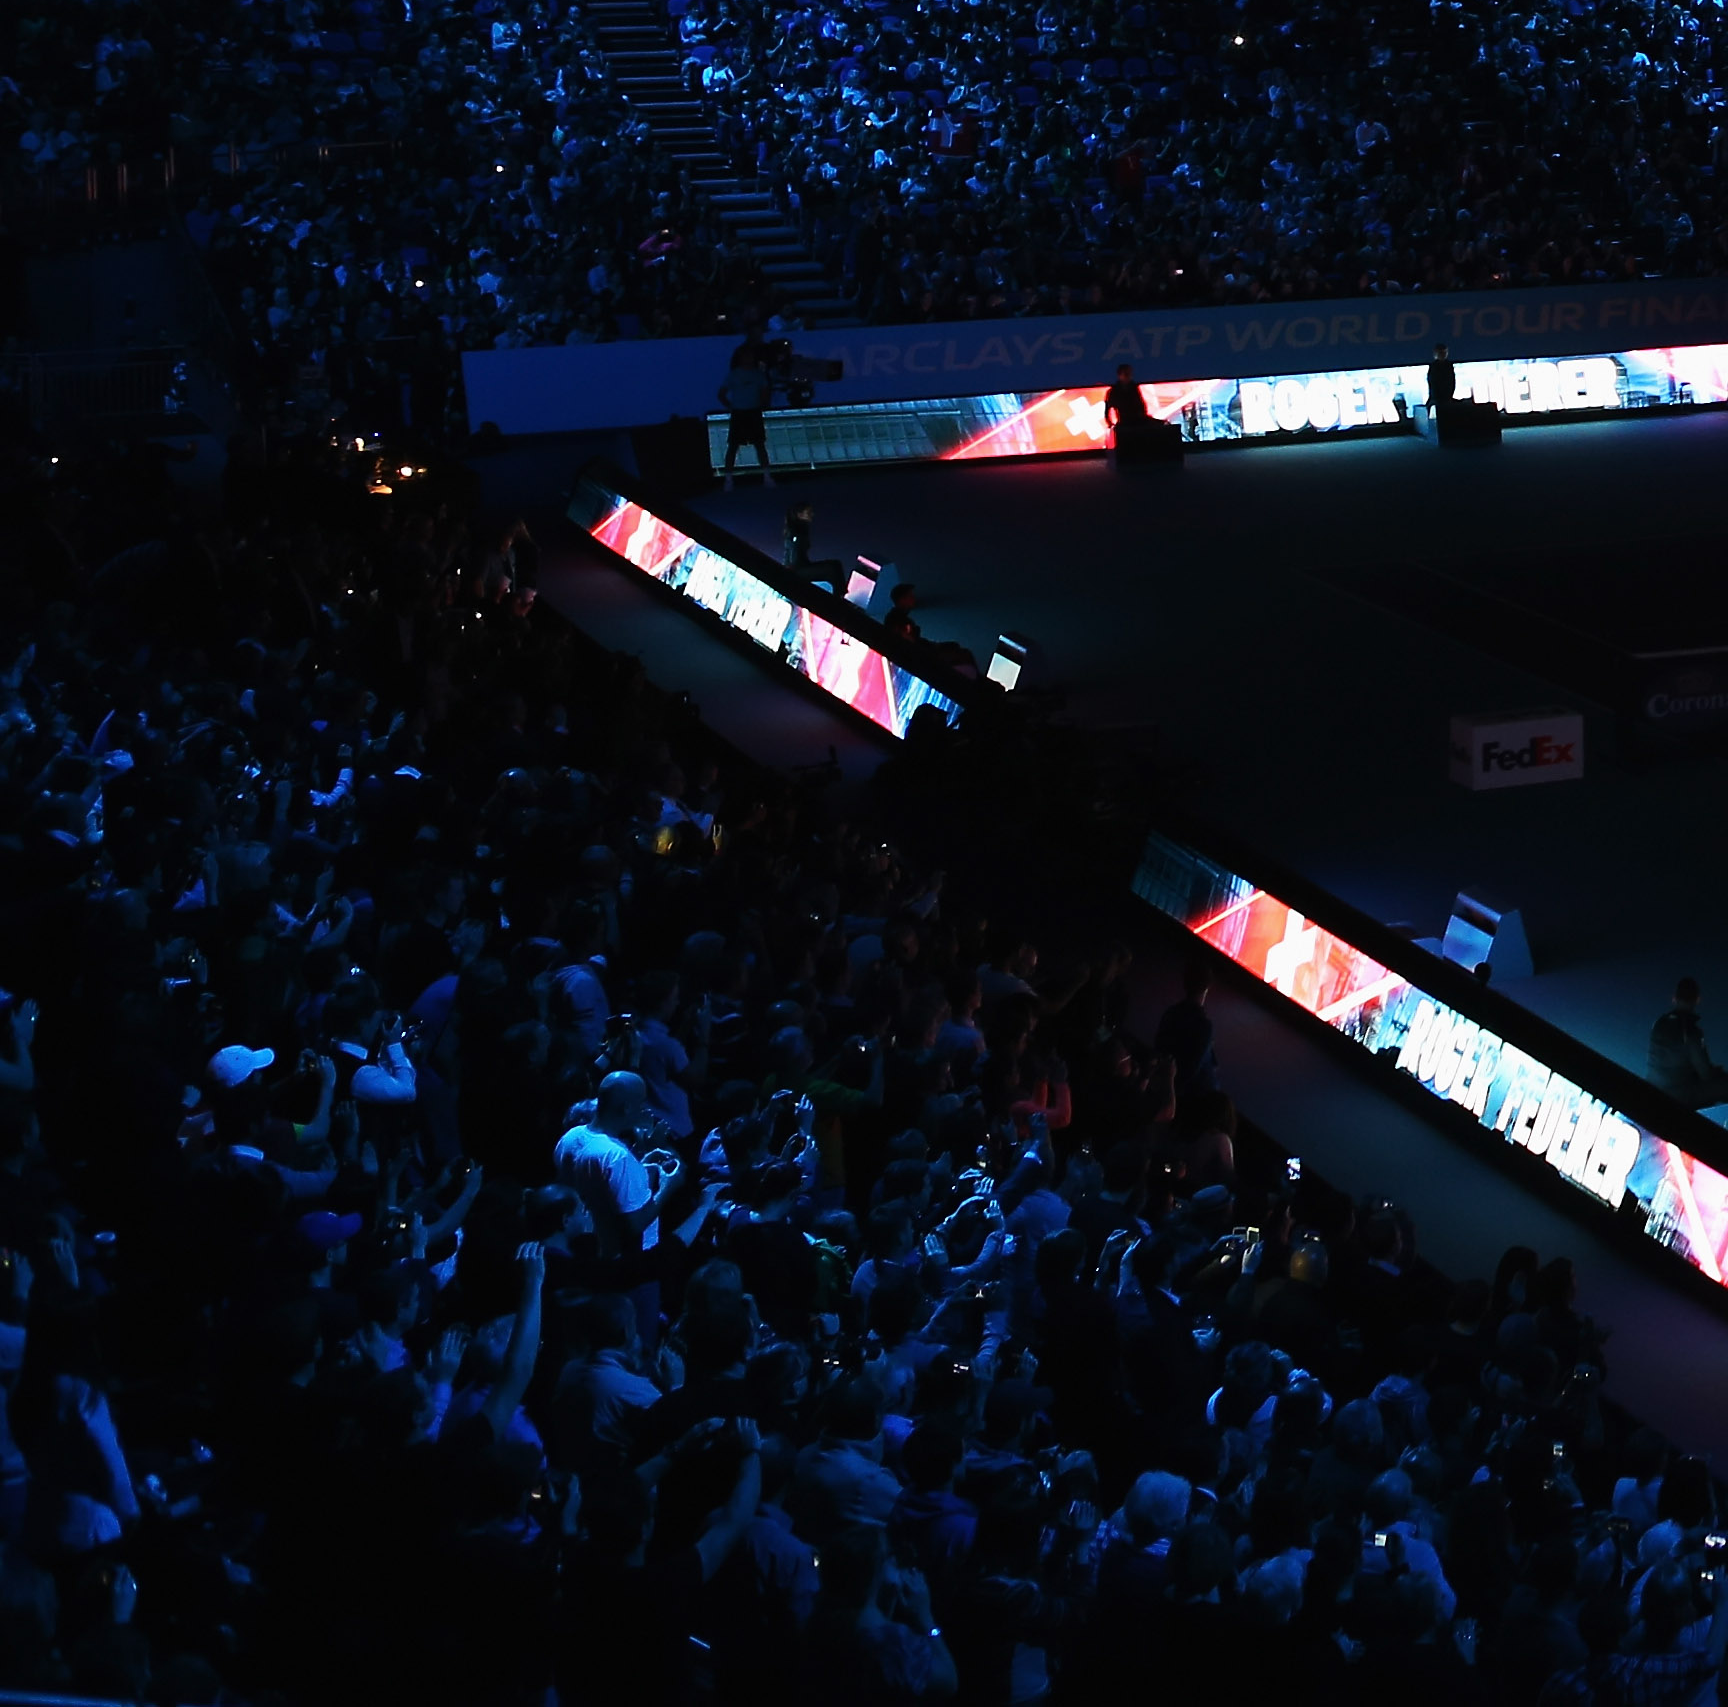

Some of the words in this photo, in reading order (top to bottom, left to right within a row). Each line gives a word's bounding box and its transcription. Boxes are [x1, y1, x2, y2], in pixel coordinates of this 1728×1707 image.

[793, 331, 1086, 377] ARCLAYS
[1102, 324, 1212, 360] ATP
[1227, 309, 1432, 352] WORLD
[1444, 300, 1584, 339] TOUR
[1240, 373, 1400, 434] ROGER
[1482, 736, 1576, 772] FedEx
[1395, 998, 1500, 1117] ROGER
[1495, 1059, 1642, 1209] FEDERER
